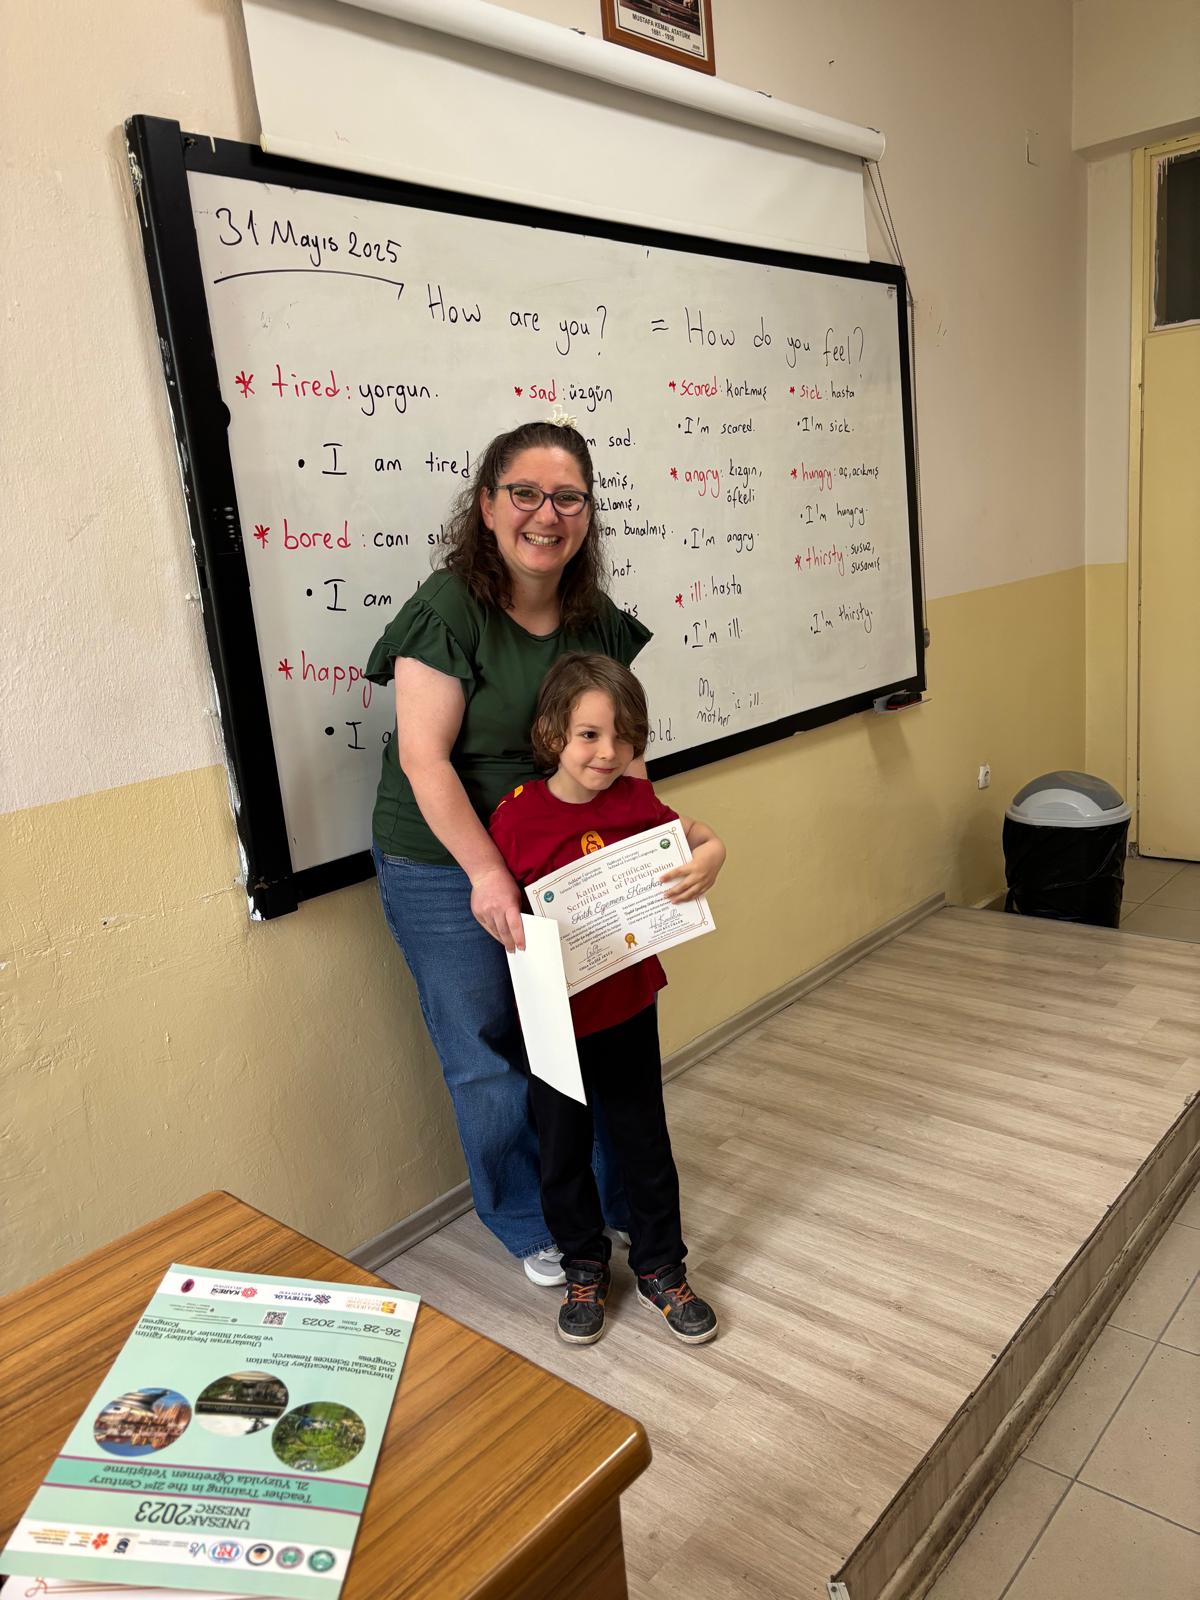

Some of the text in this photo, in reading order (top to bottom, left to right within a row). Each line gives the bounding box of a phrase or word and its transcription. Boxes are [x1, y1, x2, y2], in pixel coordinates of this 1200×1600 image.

[632, 13, 654, 26] MUSTAFA
[655, 22, 670, 33] KEMAL
[215, 207, 259, 246] 31
[348, 231, 402, 263] 2025
[427, 283, 481, 323] How
[510, 311, 540, 331] are
[556, 305, 607, 356] you?
[685, 306, 736, 346] How
[753, 316, 772, 347] do
[786, 335, 811, 368] you
[822, 327, 864, 379] feel?
[831, 381, 855, 398] hasta
[359, 384, 439, 416] yorgun.
[684, 417, 710, 434] I'm
[801, 417, 823, 432] I'm
[322, 443, 471, 478] I am tired
[711, 574, 742, 595] hasta
[324, 578, 392, 611] I am
[698, 677, 715, 712] My
[345, 721, 366, 749] I
[649, 718, 677, 743] old.
[612, 862, 652, 882] Certificate
[624, 862, 674, 886] Participation
[301, 1317, 336, 1328] 2023
[363, 1324, 401, 1337] 26-28
[246, 1357, 394, 1380] International Necatibey Education
[352, 1361, 378, 1372] Social
[358, 1355, 397, 1368] Congress
[379, 1365, 396, 1374] and
[103, 1464, 168, 1480] Yetiştirme
[172, 1470, 234, 1486] Öğretmen
[89, 1475, 143, 1489] Century
[167, 1481, 188, 1493] the
[191, 1483, 204, 1494] in
[237, 1474, 292, 1489] Yüzyılda
[207, 1483, 259, 1498] Training
[263, 1490, 313, 1504] Teacher
[134, 1501, 250, 1531] UNESAK 2023
[196, 1503, 251, 1518] INESRC
